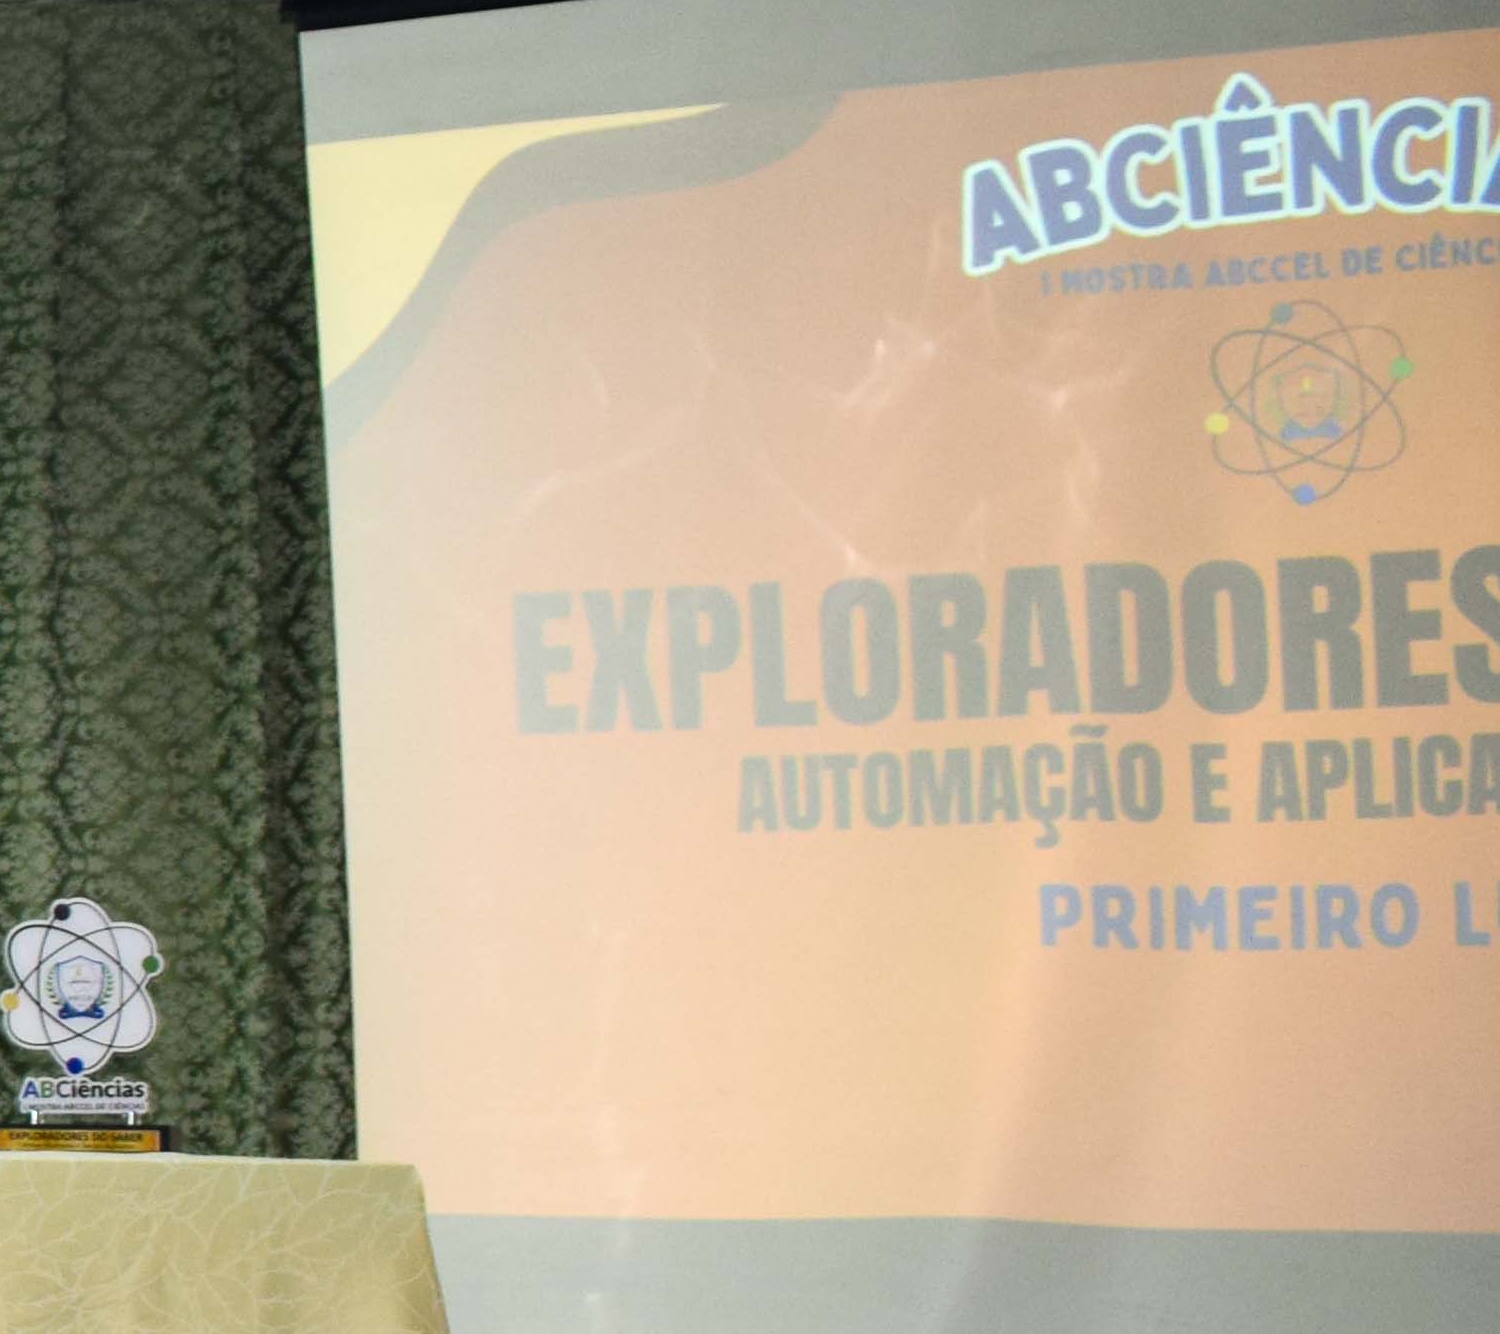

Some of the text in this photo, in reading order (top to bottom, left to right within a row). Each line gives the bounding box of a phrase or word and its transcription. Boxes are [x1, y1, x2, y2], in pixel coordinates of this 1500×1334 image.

[1061, 262, 1194, 295] MOSTRA
[1206, 251, 1330, 287] ABCCEL
[1341, 246, 1384, 276] DE
[511, 544, 1500, 735] EXPLORADORES
[738, 724, 1500, 849] AUTOMAÇÃO E APLICA
[1039, 879, 1500, 951] PRIMEIRO L
[23, 1079, 145, 1098] ABCiências
